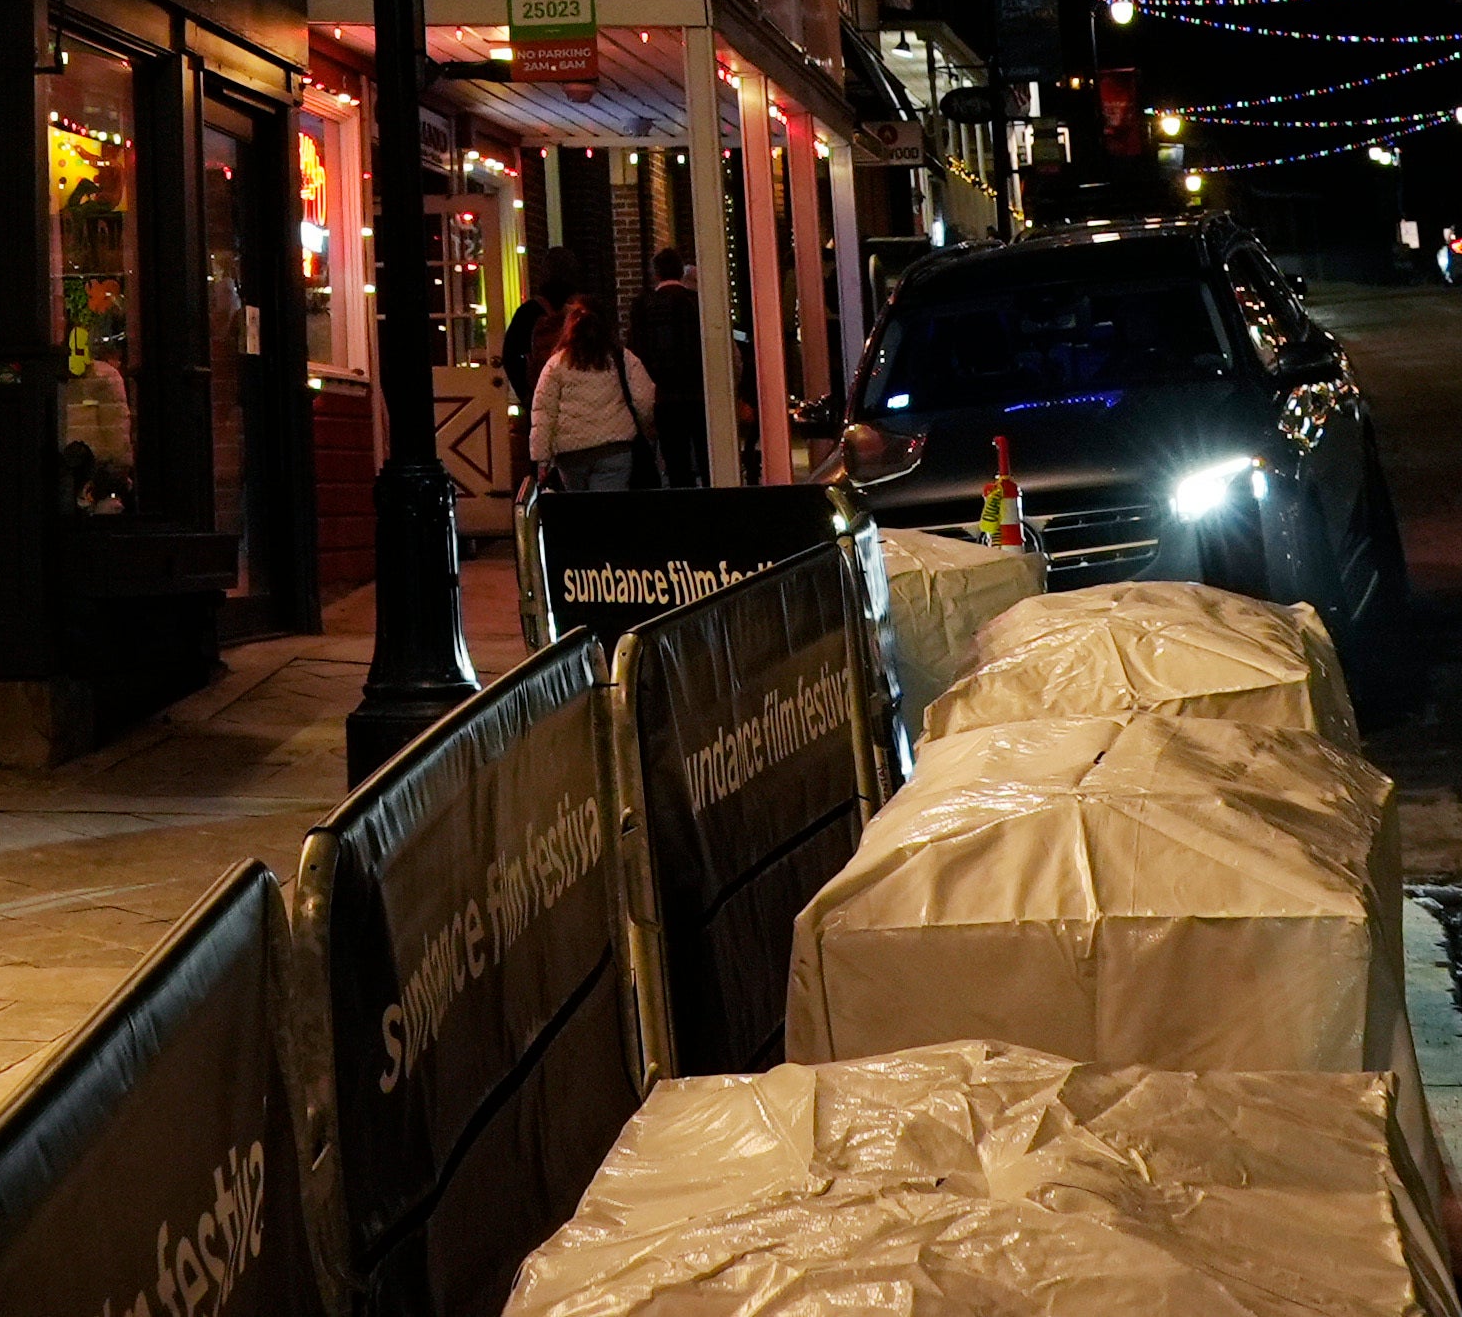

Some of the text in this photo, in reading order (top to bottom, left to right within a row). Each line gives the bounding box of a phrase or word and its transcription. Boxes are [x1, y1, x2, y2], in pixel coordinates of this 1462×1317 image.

[522, 0, 581, 20] 25023
[517, 47, 592, 60] NO PARKING
[563, 561, 670, 605] sundance
[667, 560, 719, 606] film
[685, 661, 853, 813] undance film festiva
[527, 791, 602, 918] festiva
[156, 1140, 266, 1317] festiva
